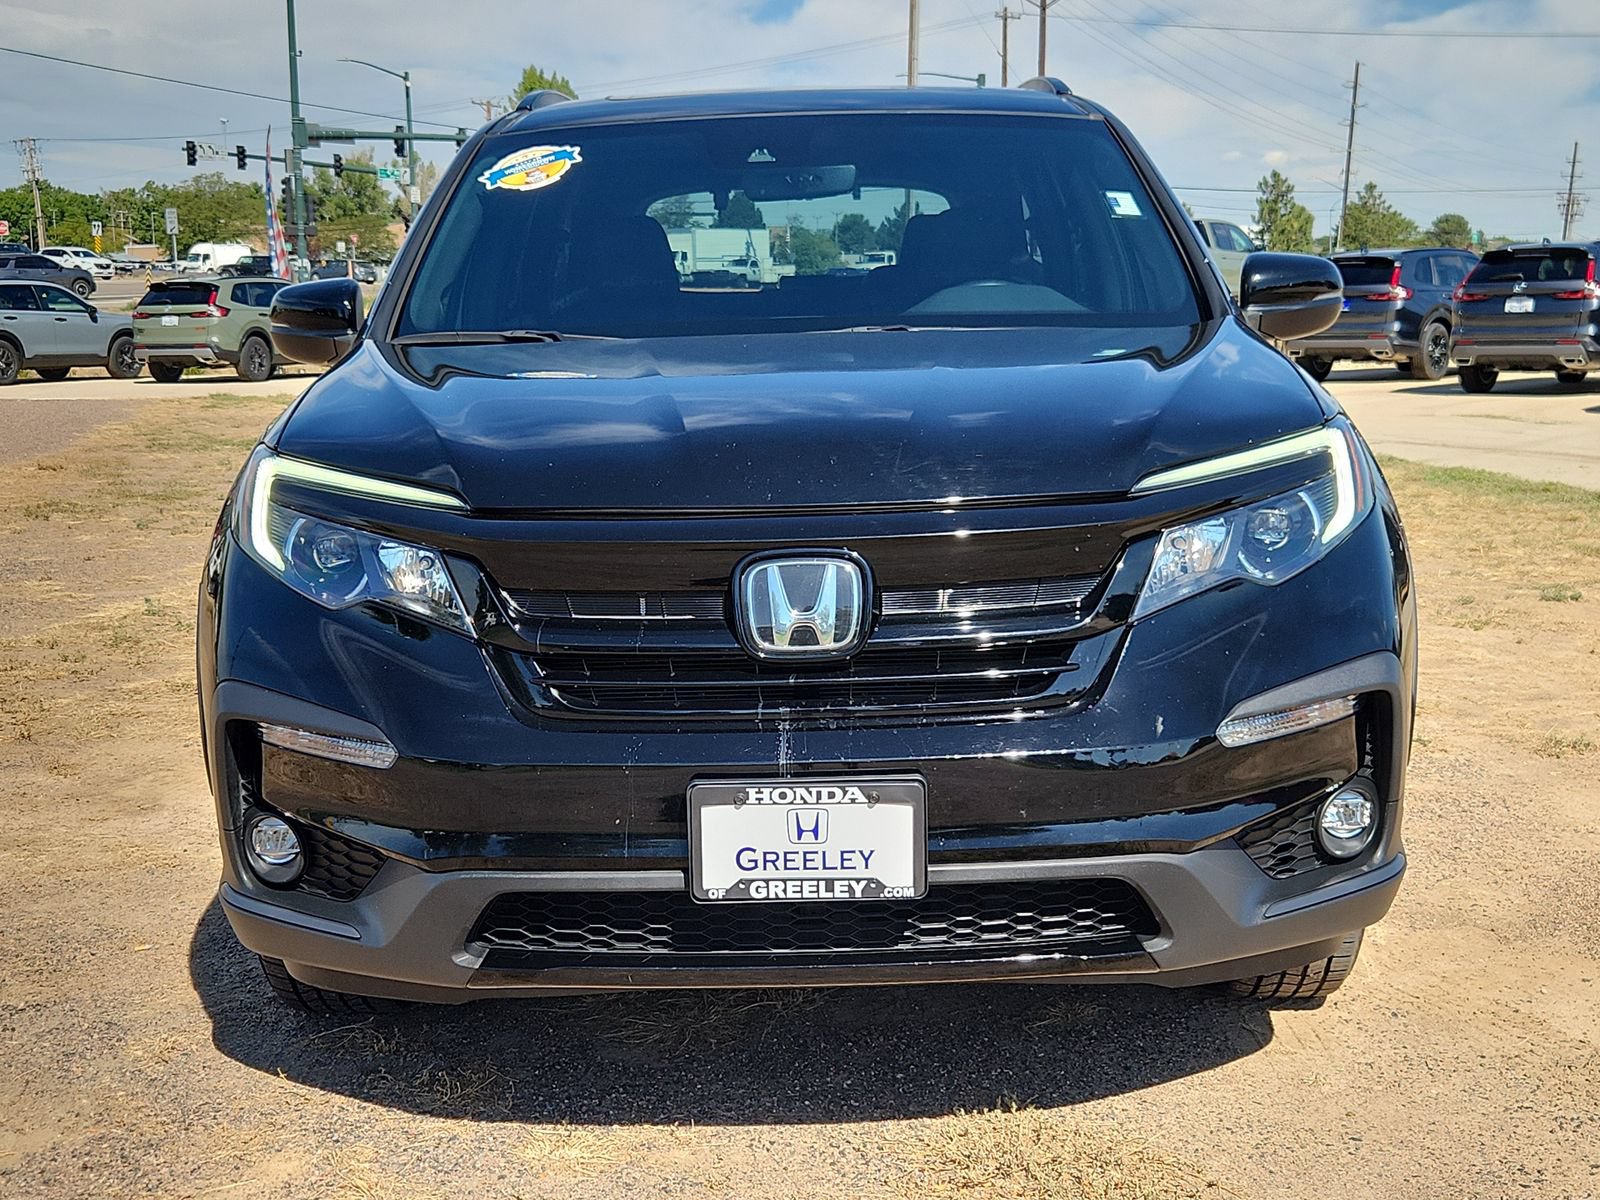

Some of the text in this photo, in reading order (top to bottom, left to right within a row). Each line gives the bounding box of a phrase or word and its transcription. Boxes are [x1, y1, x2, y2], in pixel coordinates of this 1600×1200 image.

[745, 787, 869, 804] HONDA
[736, 847, 875, 871] GREELEY
[707, 888, 727, 899] OF
[750, 880, 867, 899] GREELEY
